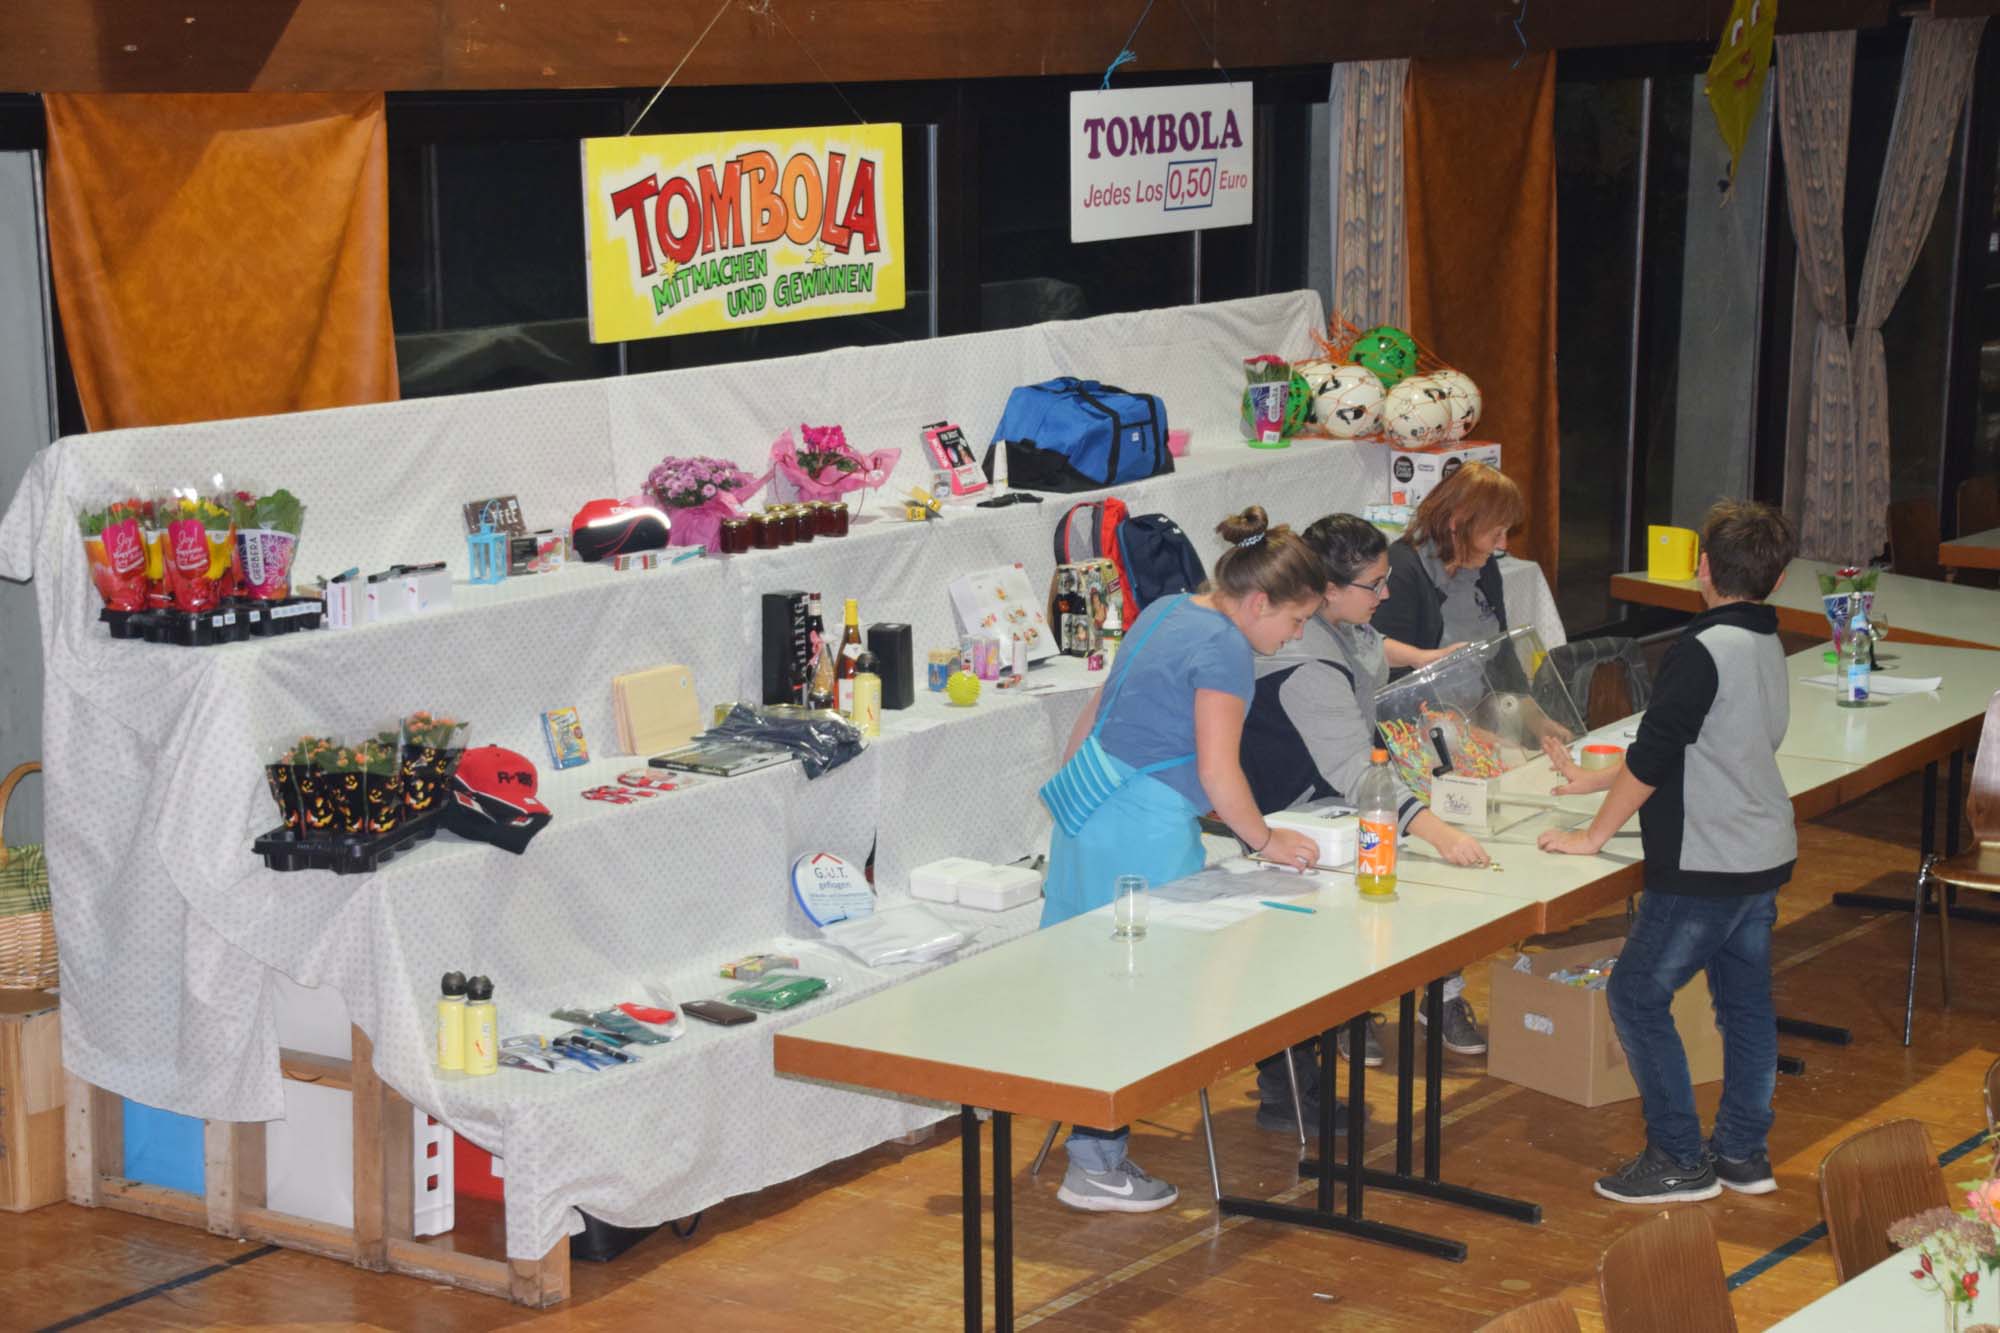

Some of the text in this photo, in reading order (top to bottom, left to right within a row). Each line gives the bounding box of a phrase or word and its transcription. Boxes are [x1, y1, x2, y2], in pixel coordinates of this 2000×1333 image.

[1083, 109, 1243, 160] TOMBOLA
[611, 150, 880, 277] TOMBOLA
[1083, 166, 1247, 208] Jedes Los 0,50 Euro
[652, 249, 768, 316] MITMACHEN
[726, 263, 873, 318] UND GEWINNEN
[249, 537, 260, 580] GERBERA
